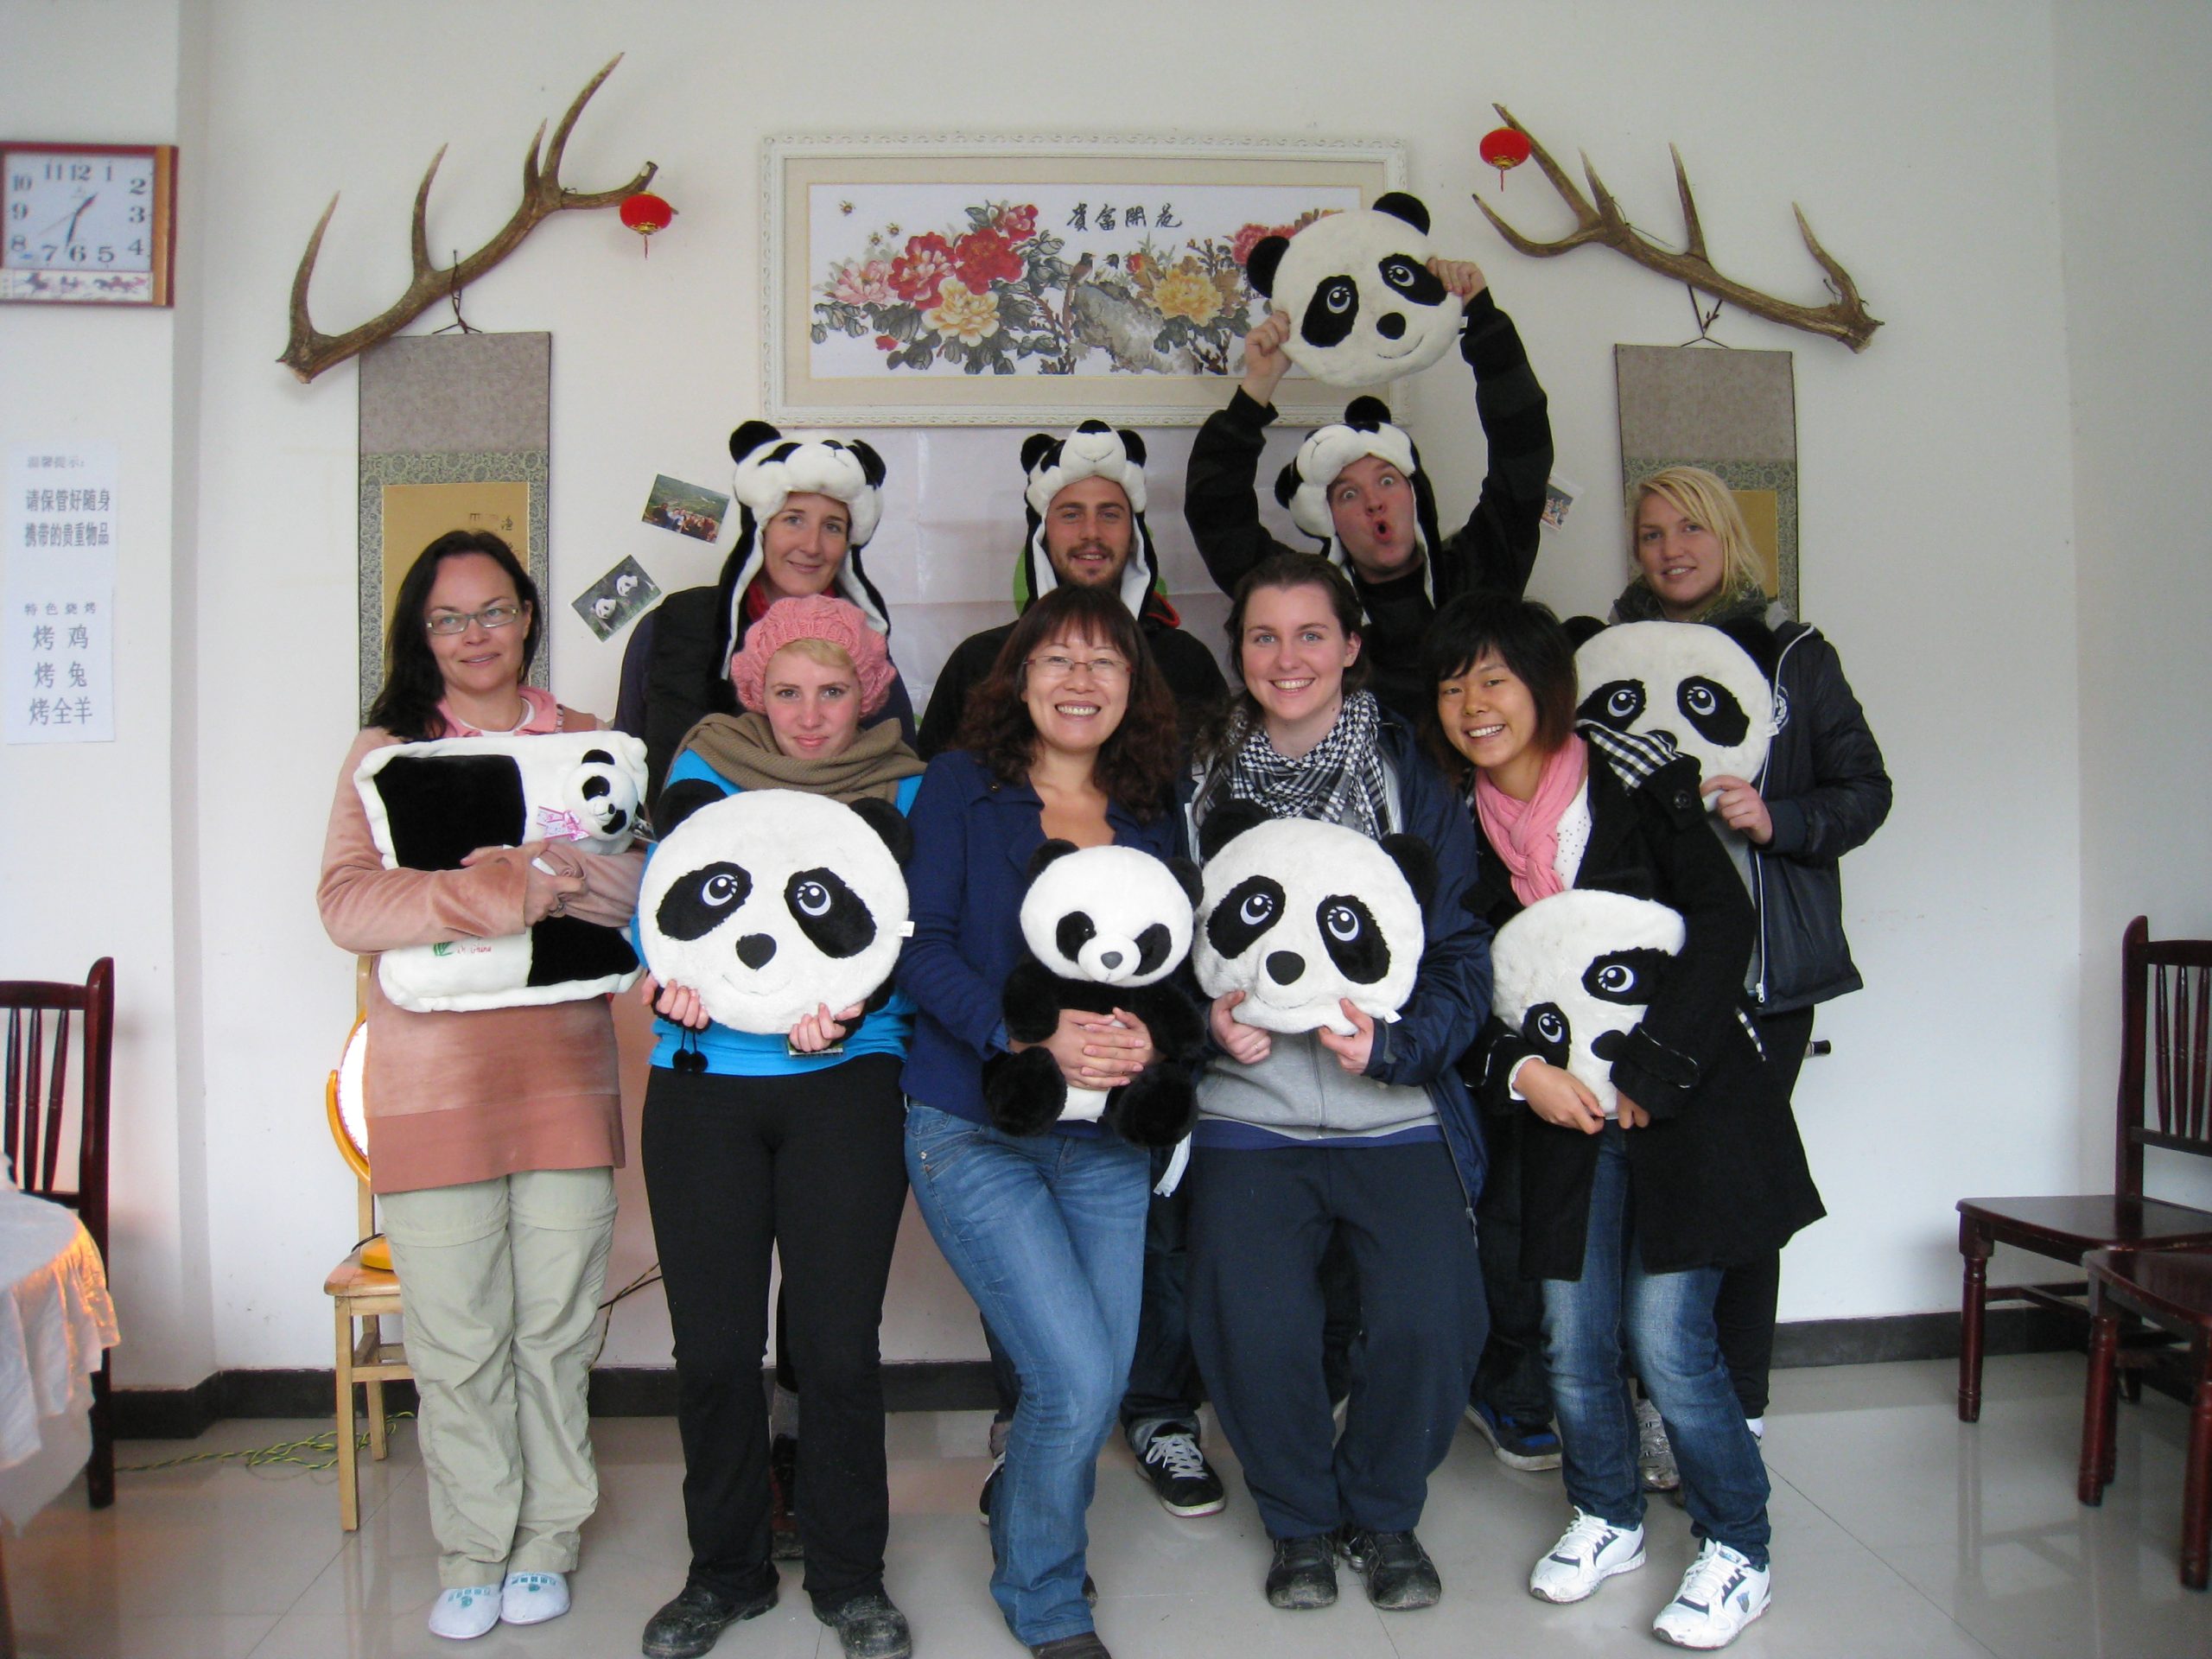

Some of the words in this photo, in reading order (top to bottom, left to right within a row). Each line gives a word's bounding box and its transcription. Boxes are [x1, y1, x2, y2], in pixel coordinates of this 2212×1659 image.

[45, 163, 62, 181] 11
[70, 164, 91, 181] 12
[105, 165, 112, 181] 1
[13, 175, 32, 191] 10
[130, 178, 146, 194] 2
[12, 203, 28, 219] 9
[130, 207, 145, 223] 3
[11, 235, 26, 251] 8
[128, 238, 143, 255] 4
[42, 245, 58, 261] 7
[69, 245, 86, 261] 6
[98, 246, 114, 263] 5
[29, 696, 92, 726] 烤全羊
